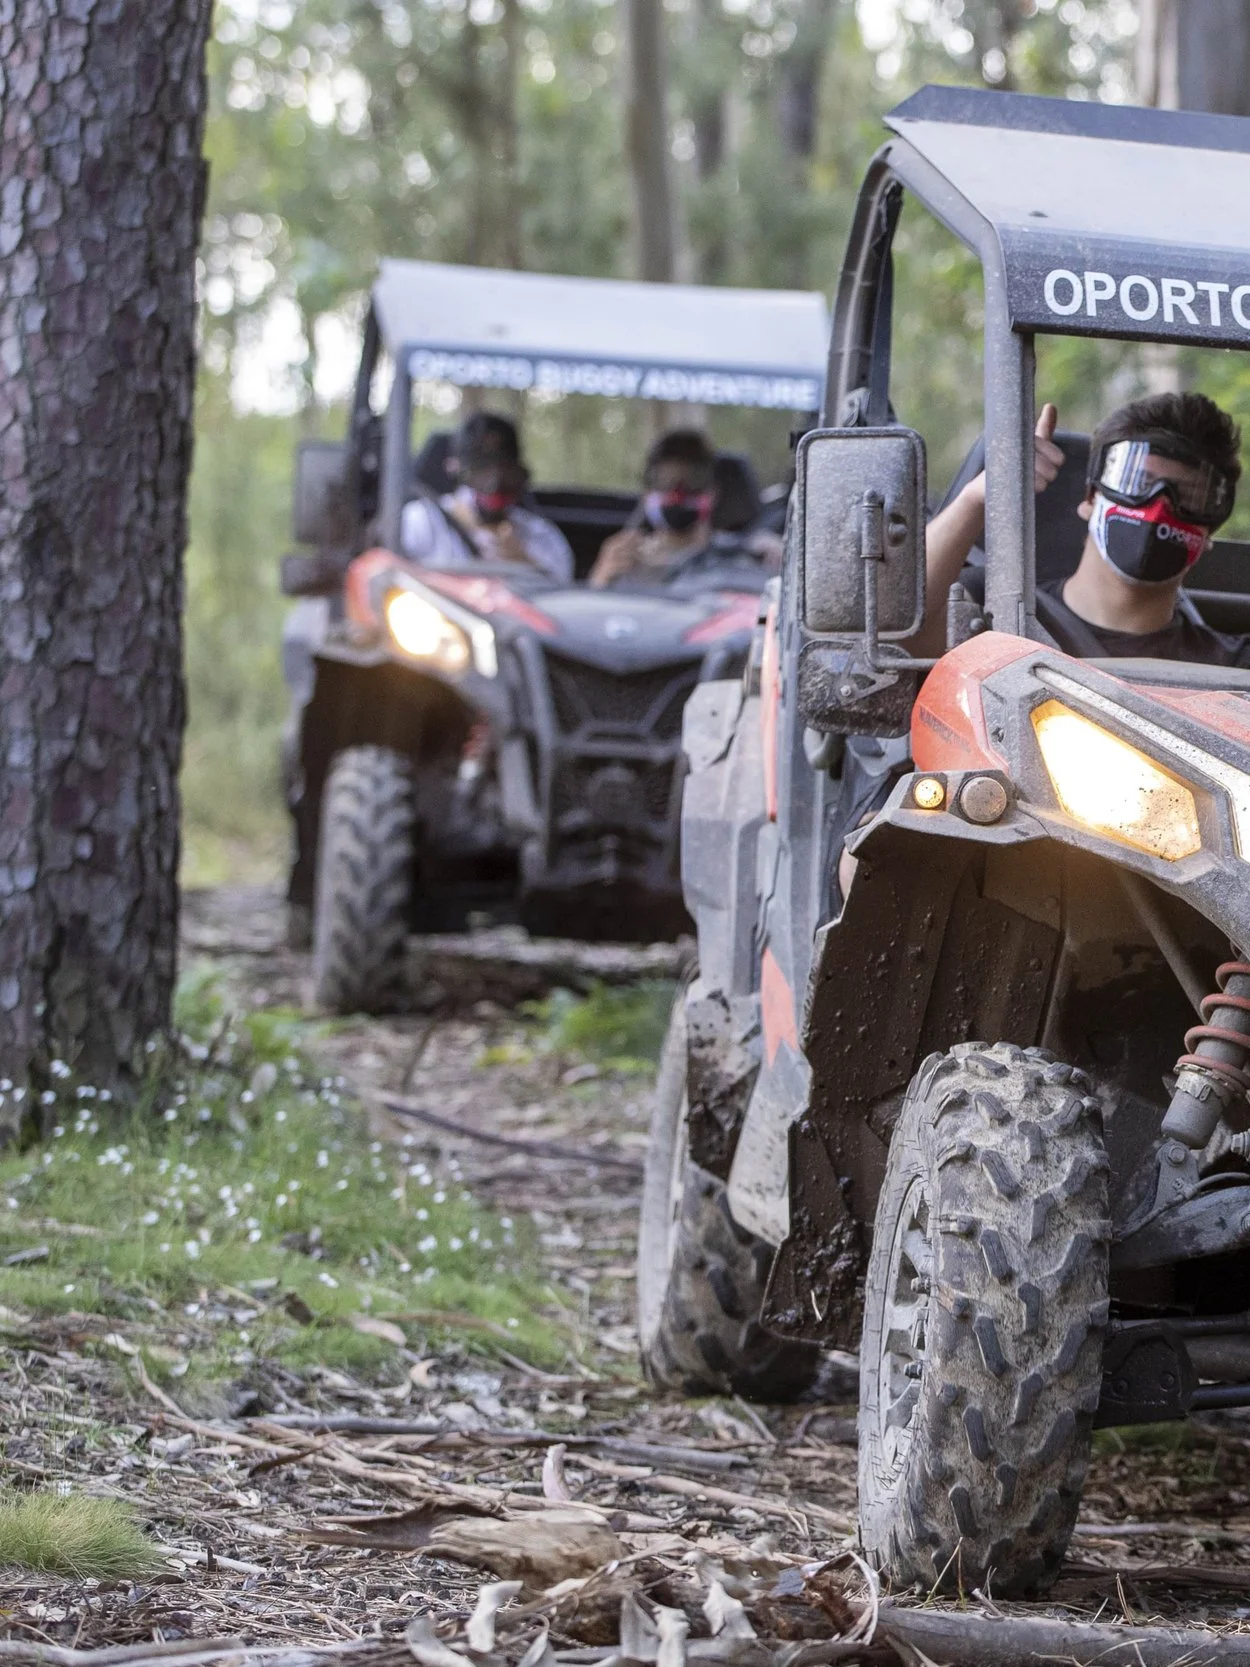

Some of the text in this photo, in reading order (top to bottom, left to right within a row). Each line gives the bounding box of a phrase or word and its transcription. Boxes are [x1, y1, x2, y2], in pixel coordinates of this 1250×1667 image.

[408, 349, 819, 410] OPORTO BUGGY ADVENTURE
